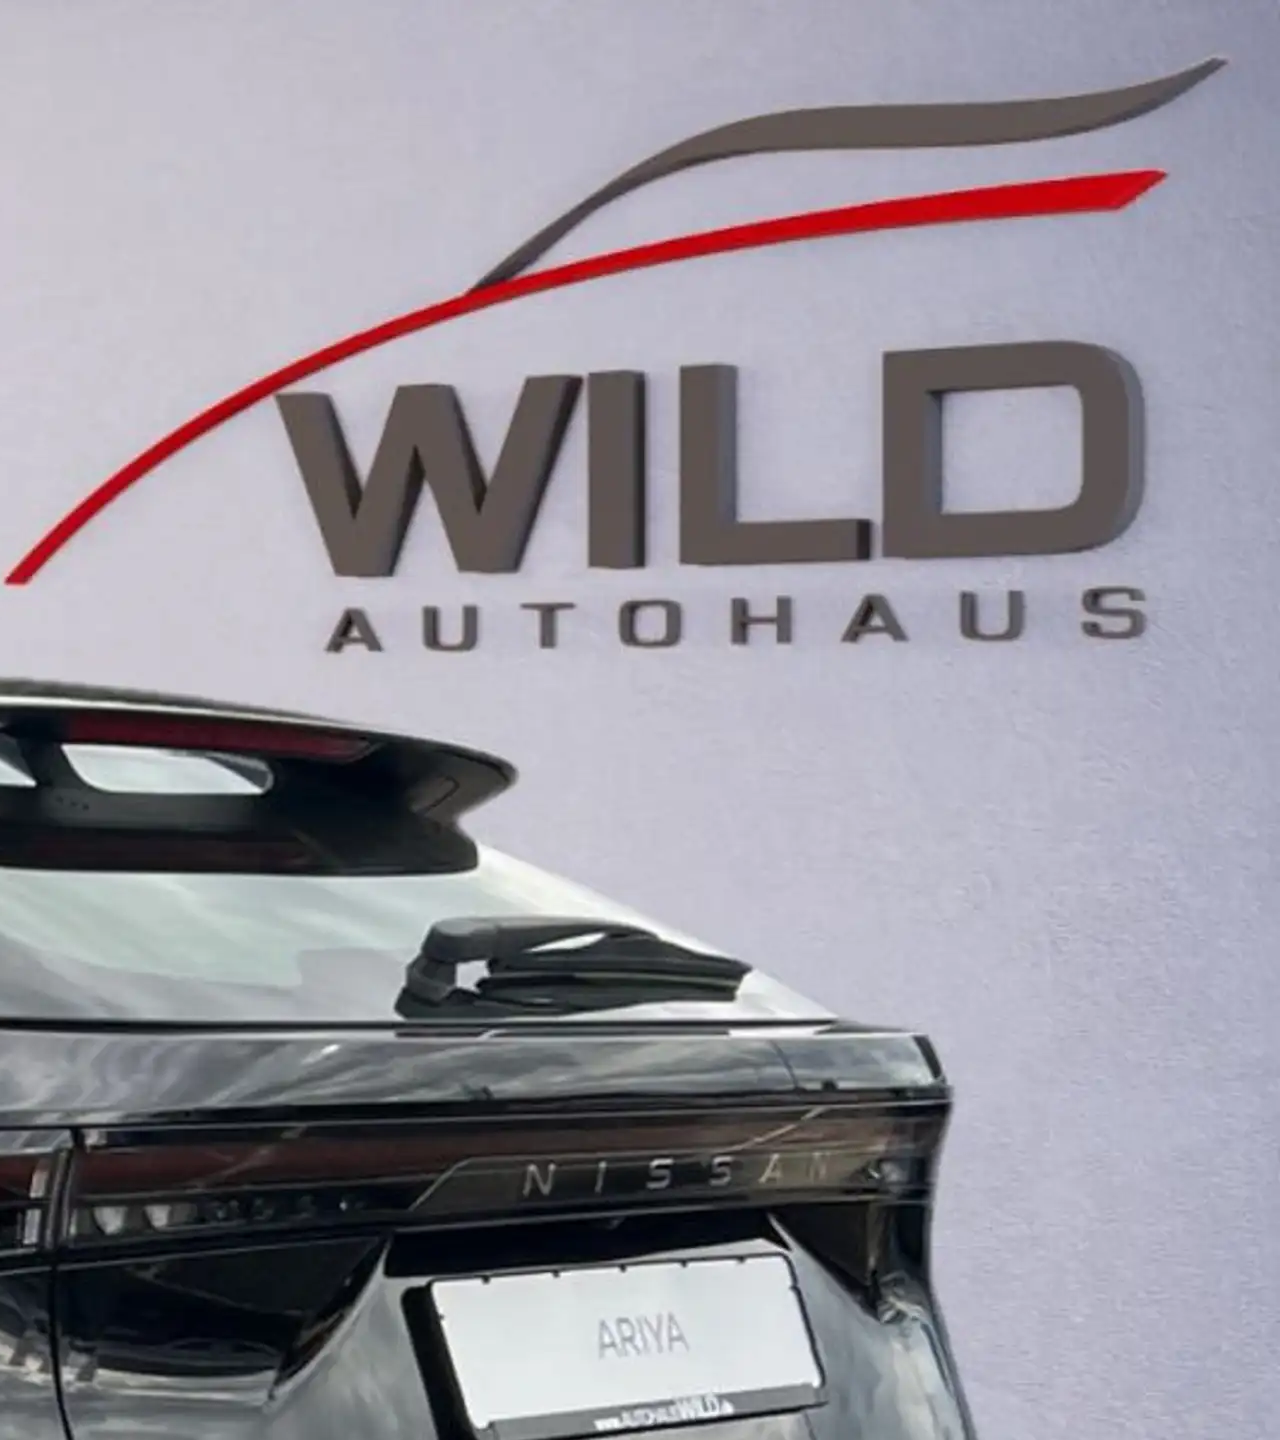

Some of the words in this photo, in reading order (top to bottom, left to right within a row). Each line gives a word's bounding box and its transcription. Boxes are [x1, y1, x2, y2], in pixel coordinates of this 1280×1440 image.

[274, 340, 1147, 578] WILD
[324, 585, 1148, 653] AUTOHAUS
[522, 1152, 831, 1197] NISSAN
[596, 1311, 690, 1358] ARIYA
